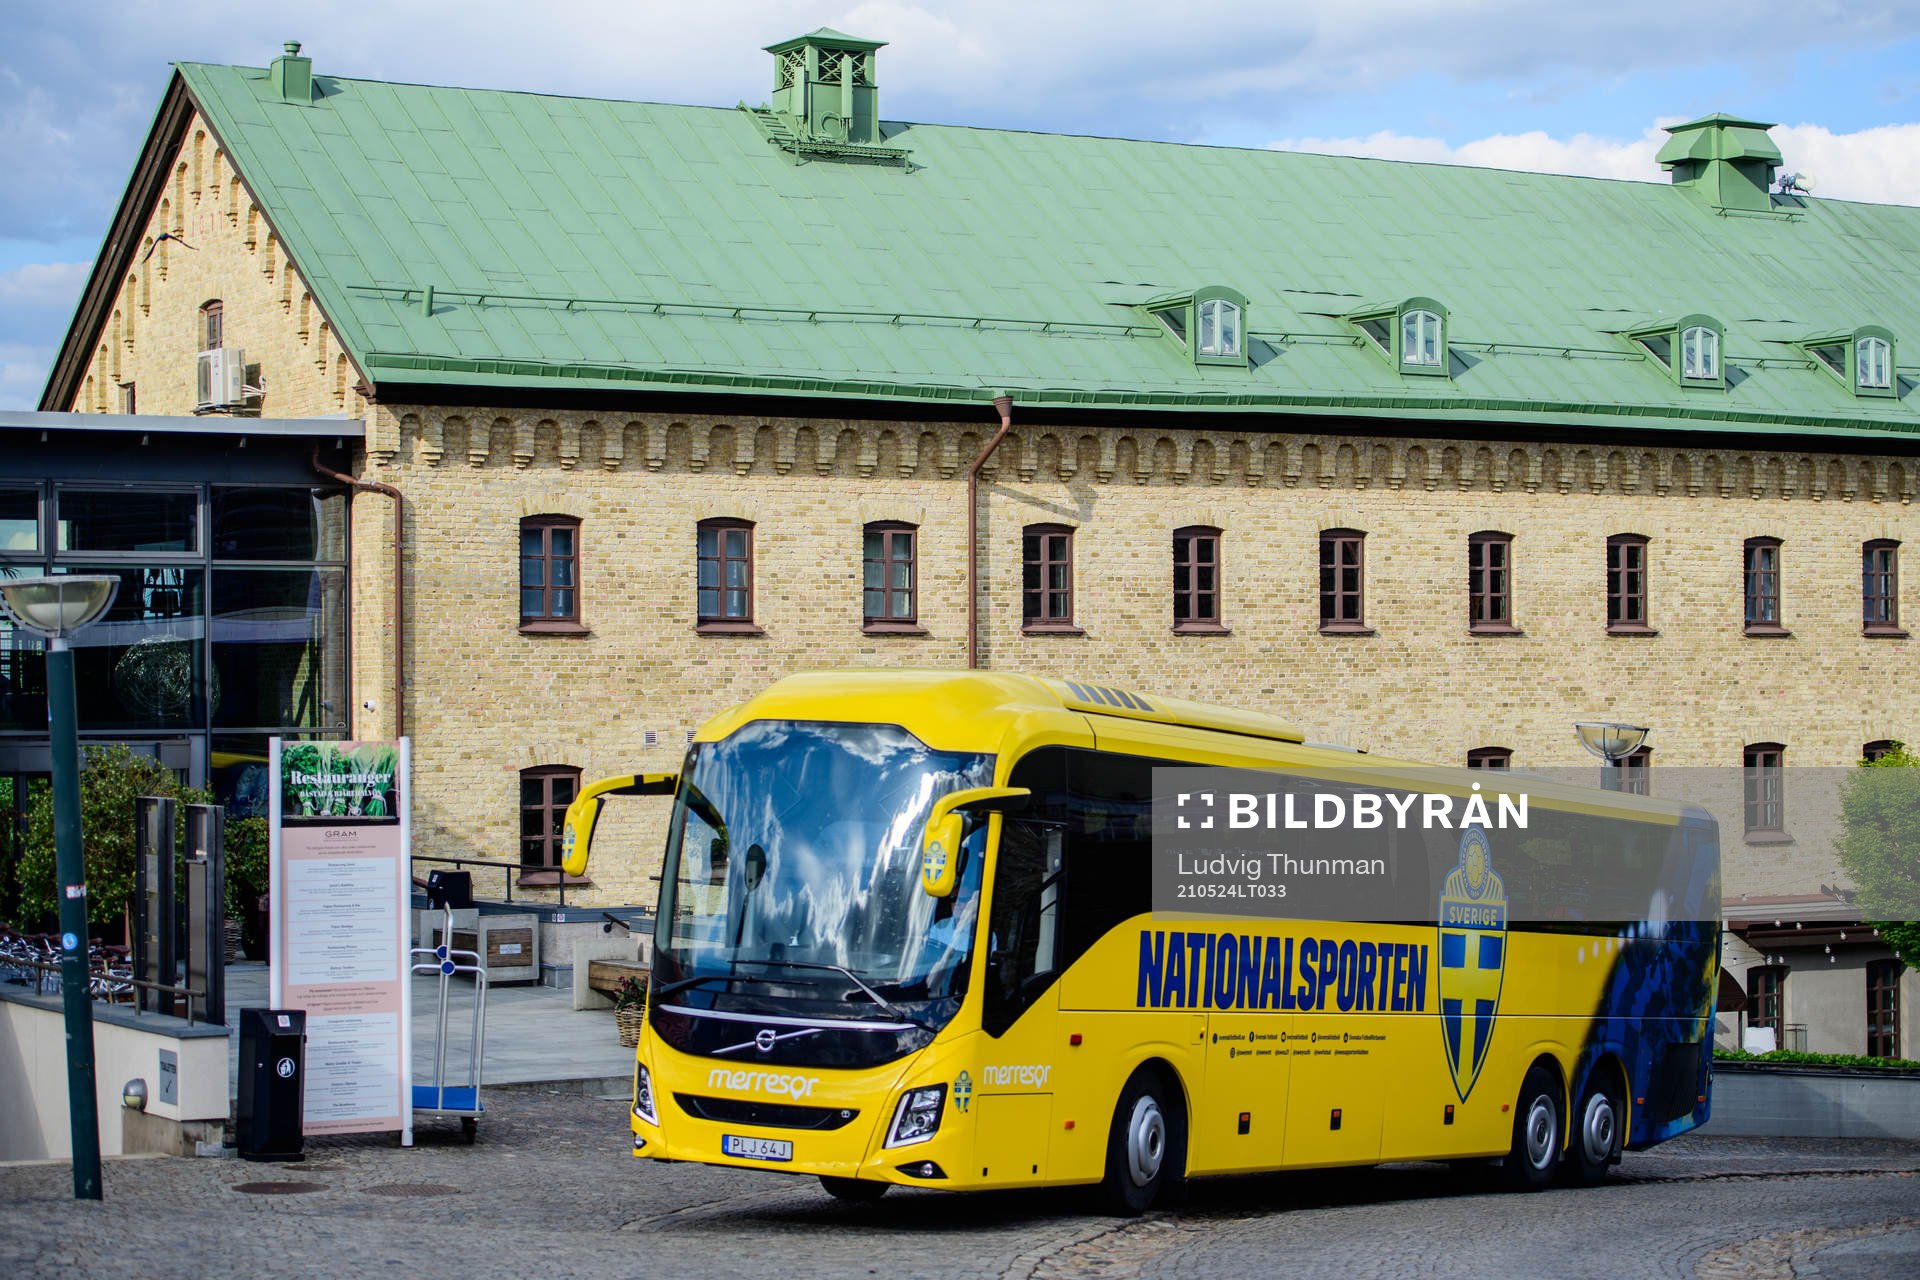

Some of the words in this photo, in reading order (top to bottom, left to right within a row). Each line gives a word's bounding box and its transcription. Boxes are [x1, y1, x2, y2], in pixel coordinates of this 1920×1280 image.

[291, 771, 391, 787] Restauranger
[1449, 906, 1498, 926] SVERIGE
[1136, 930, 1428, 1012] NATIONALSPORTEN
[708, 1069, 819, 1100] merresor
[983, 1065, 1051, 1089] merresor
[732, 1138, 757, 1153] PLJ
[760, 1141, 786, 1156] 64J
